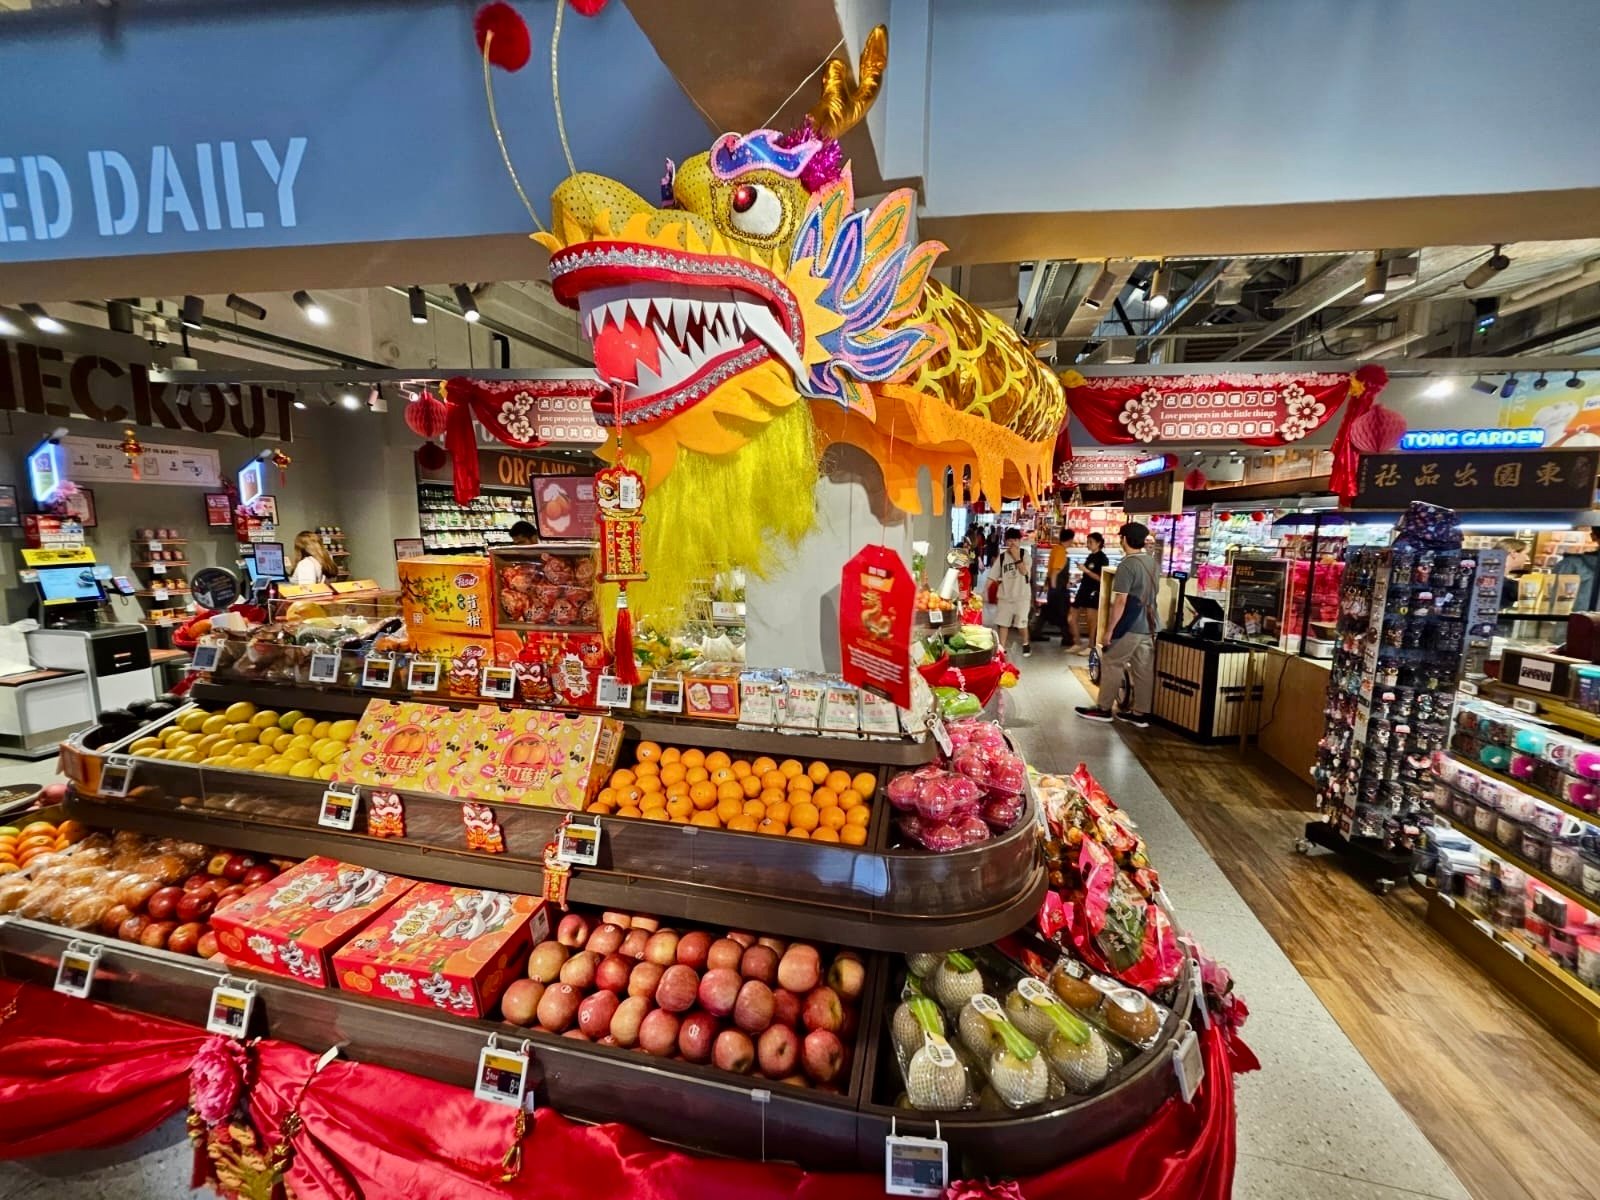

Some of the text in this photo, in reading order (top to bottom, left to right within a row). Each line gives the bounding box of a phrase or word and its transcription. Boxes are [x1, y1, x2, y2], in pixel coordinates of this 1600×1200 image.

[88, 137, 308, 237] DAILY
[1160, 408, 1277, 421] Love prospers in the little things
[1404, 430, 1545, 447] TONG GARDEN
